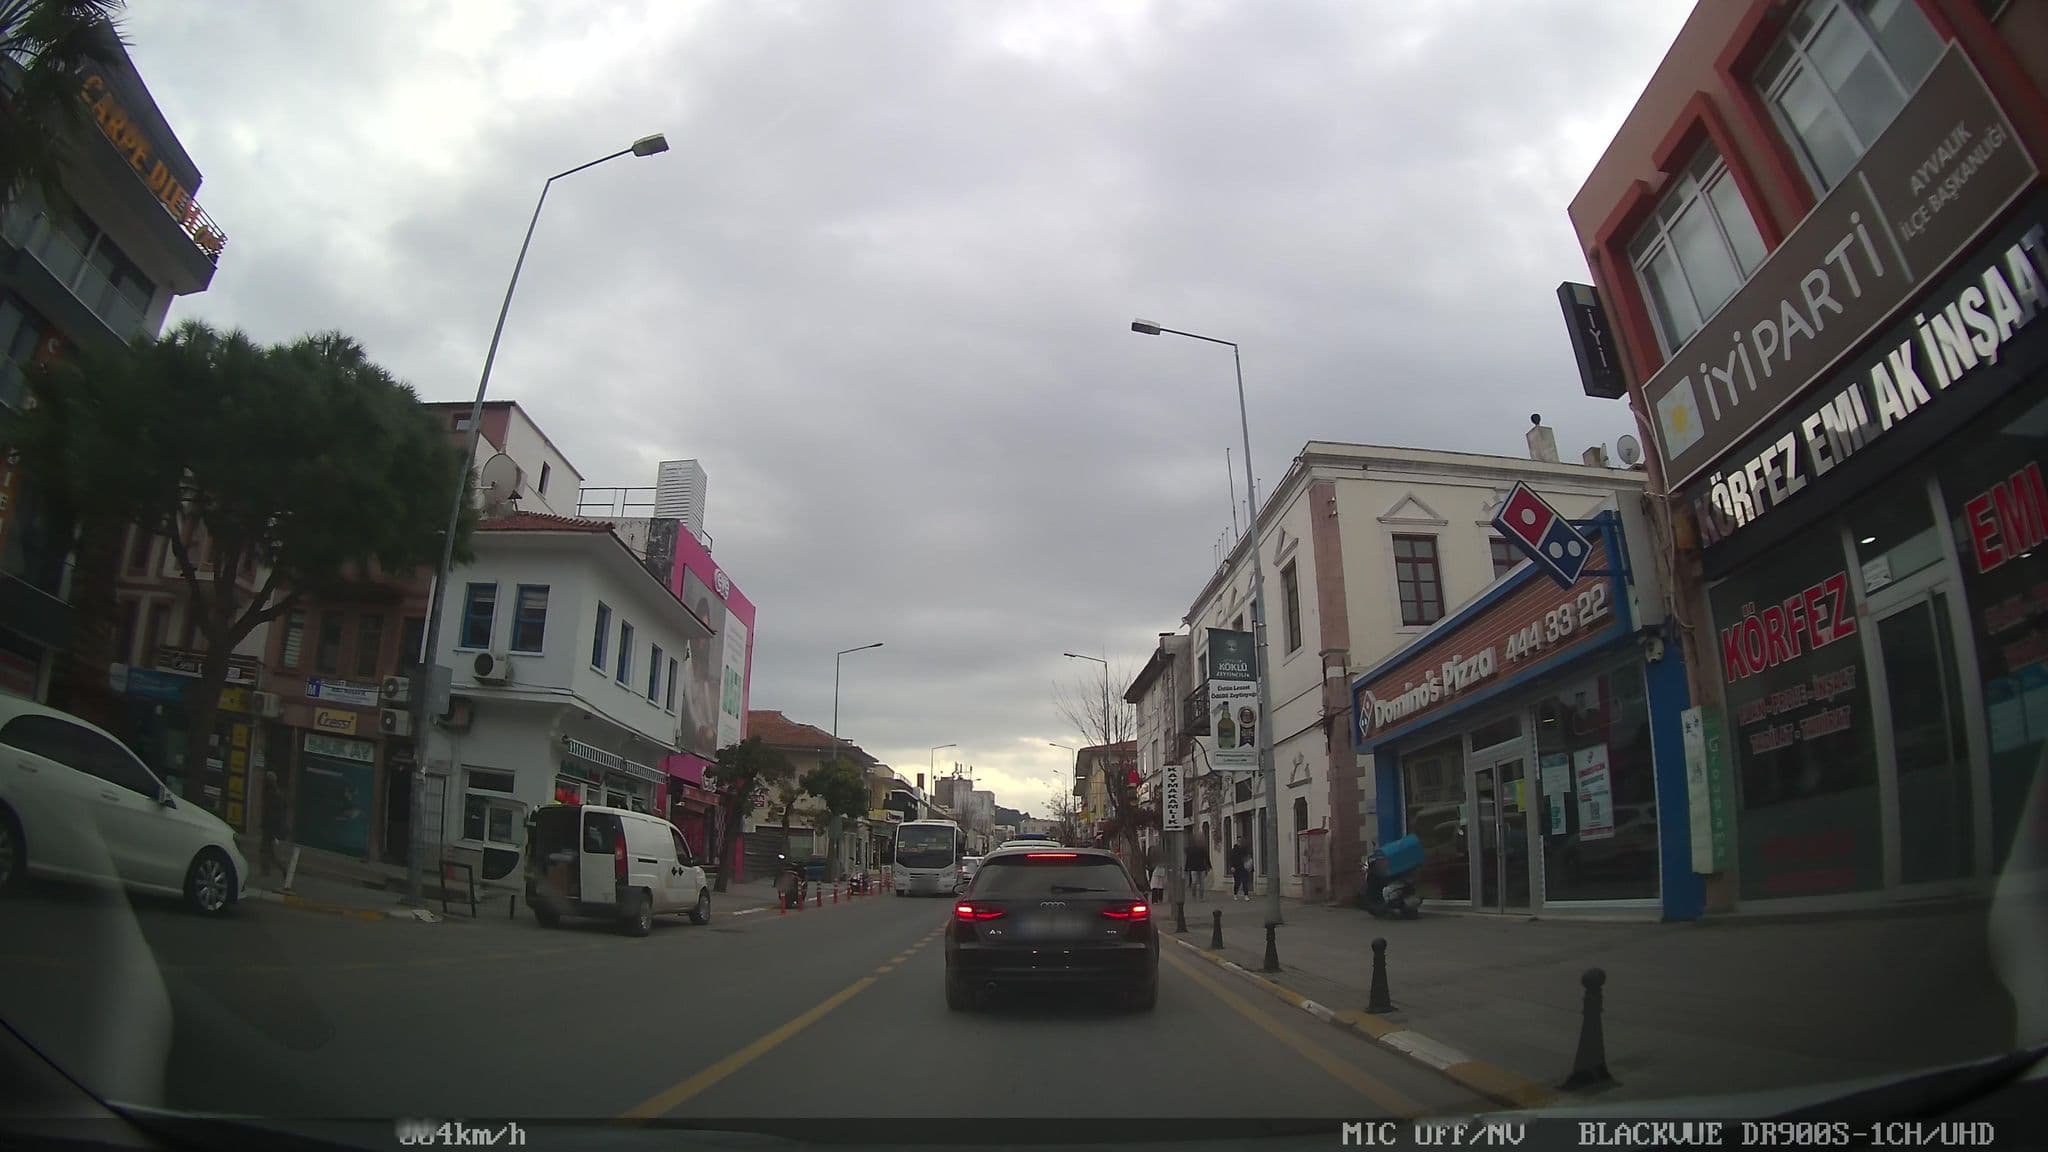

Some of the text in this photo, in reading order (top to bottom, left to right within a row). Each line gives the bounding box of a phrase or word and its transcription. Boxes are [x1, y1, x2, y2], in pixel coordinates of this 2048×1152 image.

[1898, 122, 2008, 241] İLÇE BAŞKANLIĞI
[1910, 120, 1972, 197] AYVALIK
[1694, 431, 1808, 549] KÖRFEZ
[1802, 339, 1932, 478] EMLAK
[1374, 583, 1608, 729] Domino's Pizza 444 33 22
[1721, 570, 1857, 684] KÖRFEZ
[1167, 767, 1179, 825] KAYMAKAMLIK
